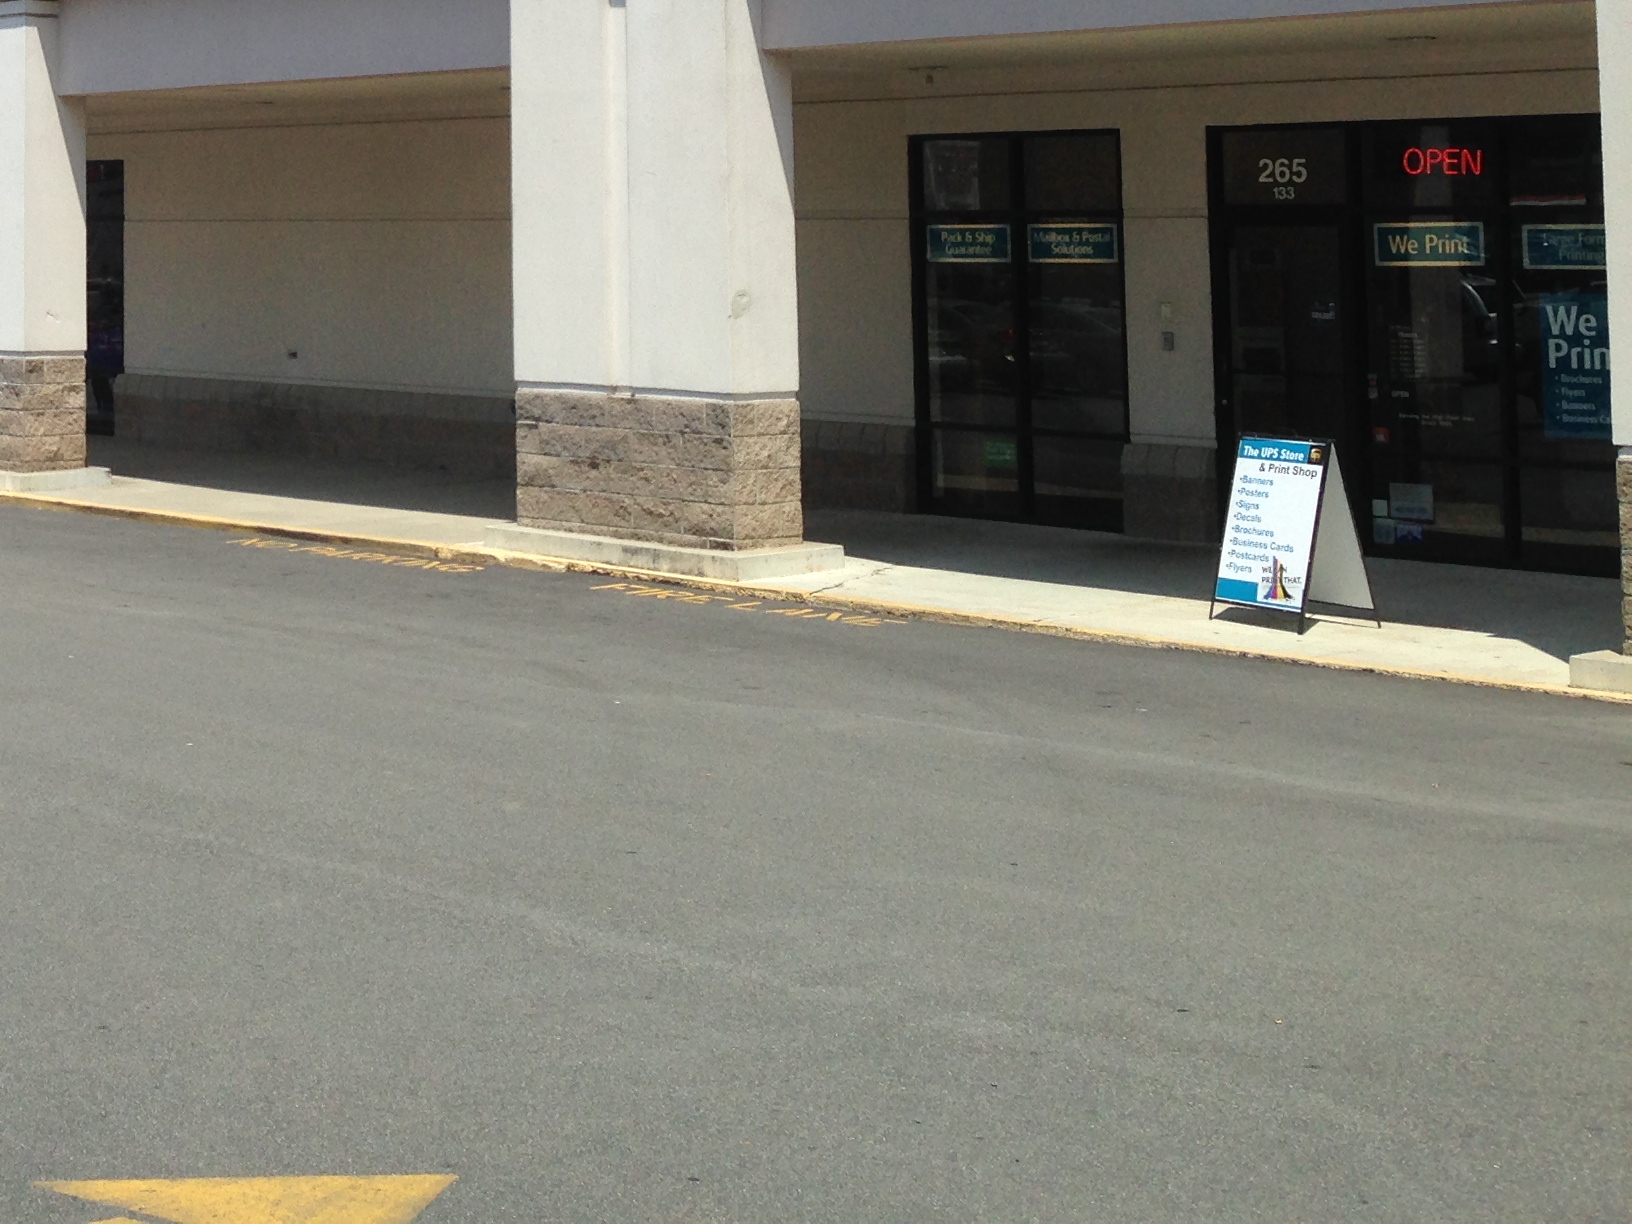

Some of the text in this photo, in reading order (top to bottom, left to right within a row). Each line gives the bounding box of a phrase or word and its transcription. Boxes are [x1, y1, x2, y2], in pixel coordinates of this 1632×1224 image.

[1402, 147, 1483, 176] OPEN
[1258, 158, 1307, 183] 265
[1273, 186, 1295, 200] 133
[1051, 242, 1094, 255] Solutions
[1388, 233, 1471, 254] We Print
[1546, 305, 1598, 336] We
[1243, 445, 1305, 461] The UPS Store
[1259, 462, 1318, 479] & Print Shop
[1242, 475, 1274, 486] Banners
[1240, 487, 1269, 498] Posters
[1238, 499, 1260, 511] Signs
[1236, 512, 1262, 523] Decals
[1234, 524, 1274, 537] Brochures
[1232, 537, 1294, 553] Business Cards
[1230, 549, 1269, 562] Postcards
[1229, 561, 1252, 573] Flyers
